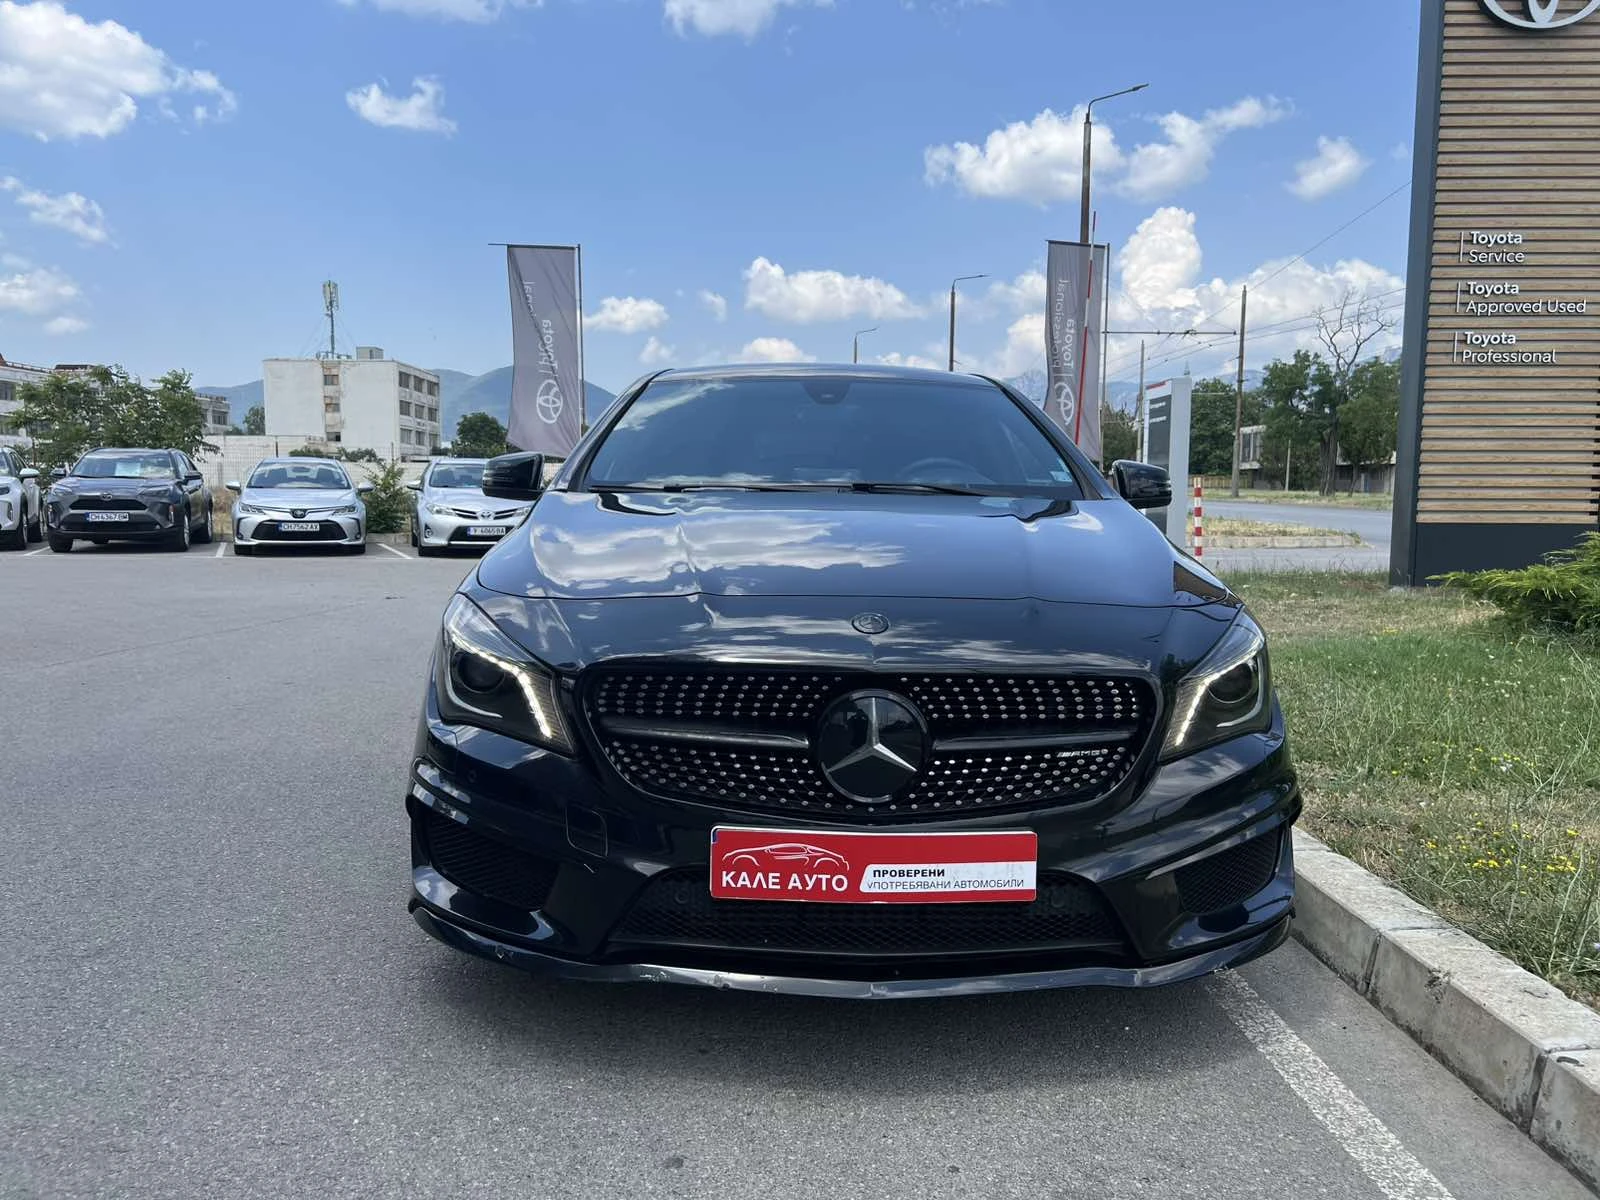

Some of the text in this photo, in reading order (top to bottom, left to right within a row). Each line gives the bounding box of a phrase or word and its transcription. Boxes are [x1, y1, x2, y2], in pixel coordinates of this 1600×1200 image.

[1470, 231, 1523, 247] Toyota
[1468, 249, 1526, 263] Service
[1467, 281, 1520, 297] Toyota
[1465, 298, 1587, 316] Approved Used
[1464, 331, 1517, 347] Toyota
[1462, 349, 1556, 363] Professional
[721, 870, 849, 892] КАЛЕ АУТО
[873, 868, 945, 878] ПРОВЕРЕНИ
[867, 878, 1025, 890] УПОТРЕБЯВАНИ АВТОМОБИЛИ
